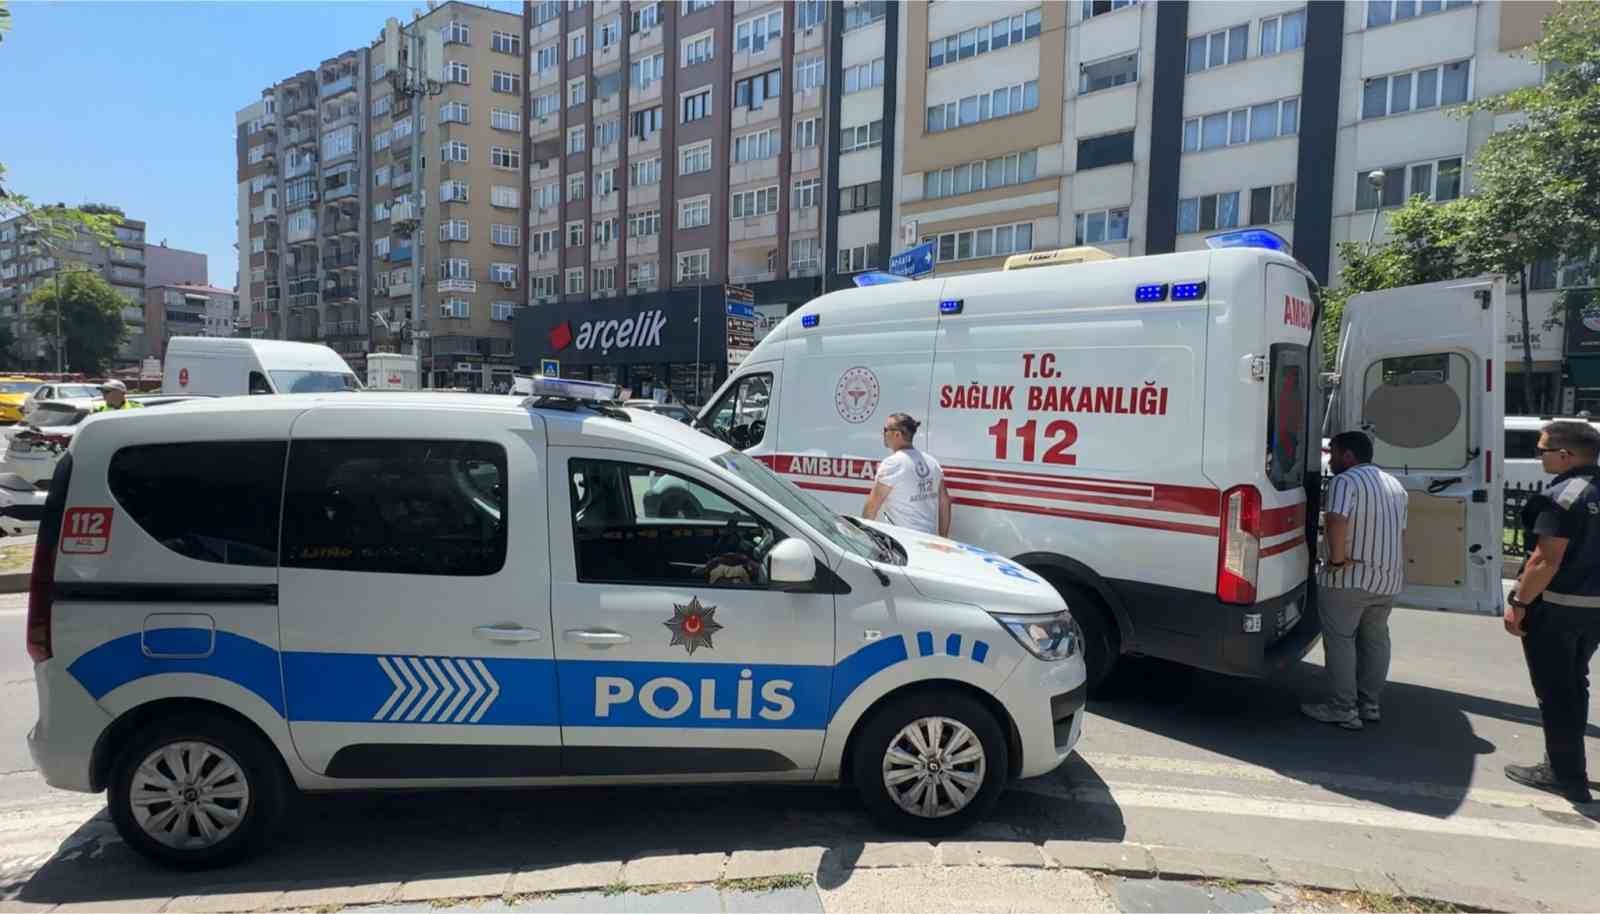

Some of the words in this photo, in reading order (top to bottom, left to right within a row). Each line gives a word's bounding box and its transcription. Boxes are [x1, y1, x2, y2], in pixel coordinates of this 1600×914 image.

[576, 310, 667, 356] arçelik
[1023, 353, 1062, 378] T.C.
[940, 381, 1015, 410] SAĞLIK
[1027, 381, 1169, 415] BAKANLIĞI
[988, 418, 1078, 466] 112
[72, 512, 105, 534] 112
[594, 668, 796, 720] POLİS
